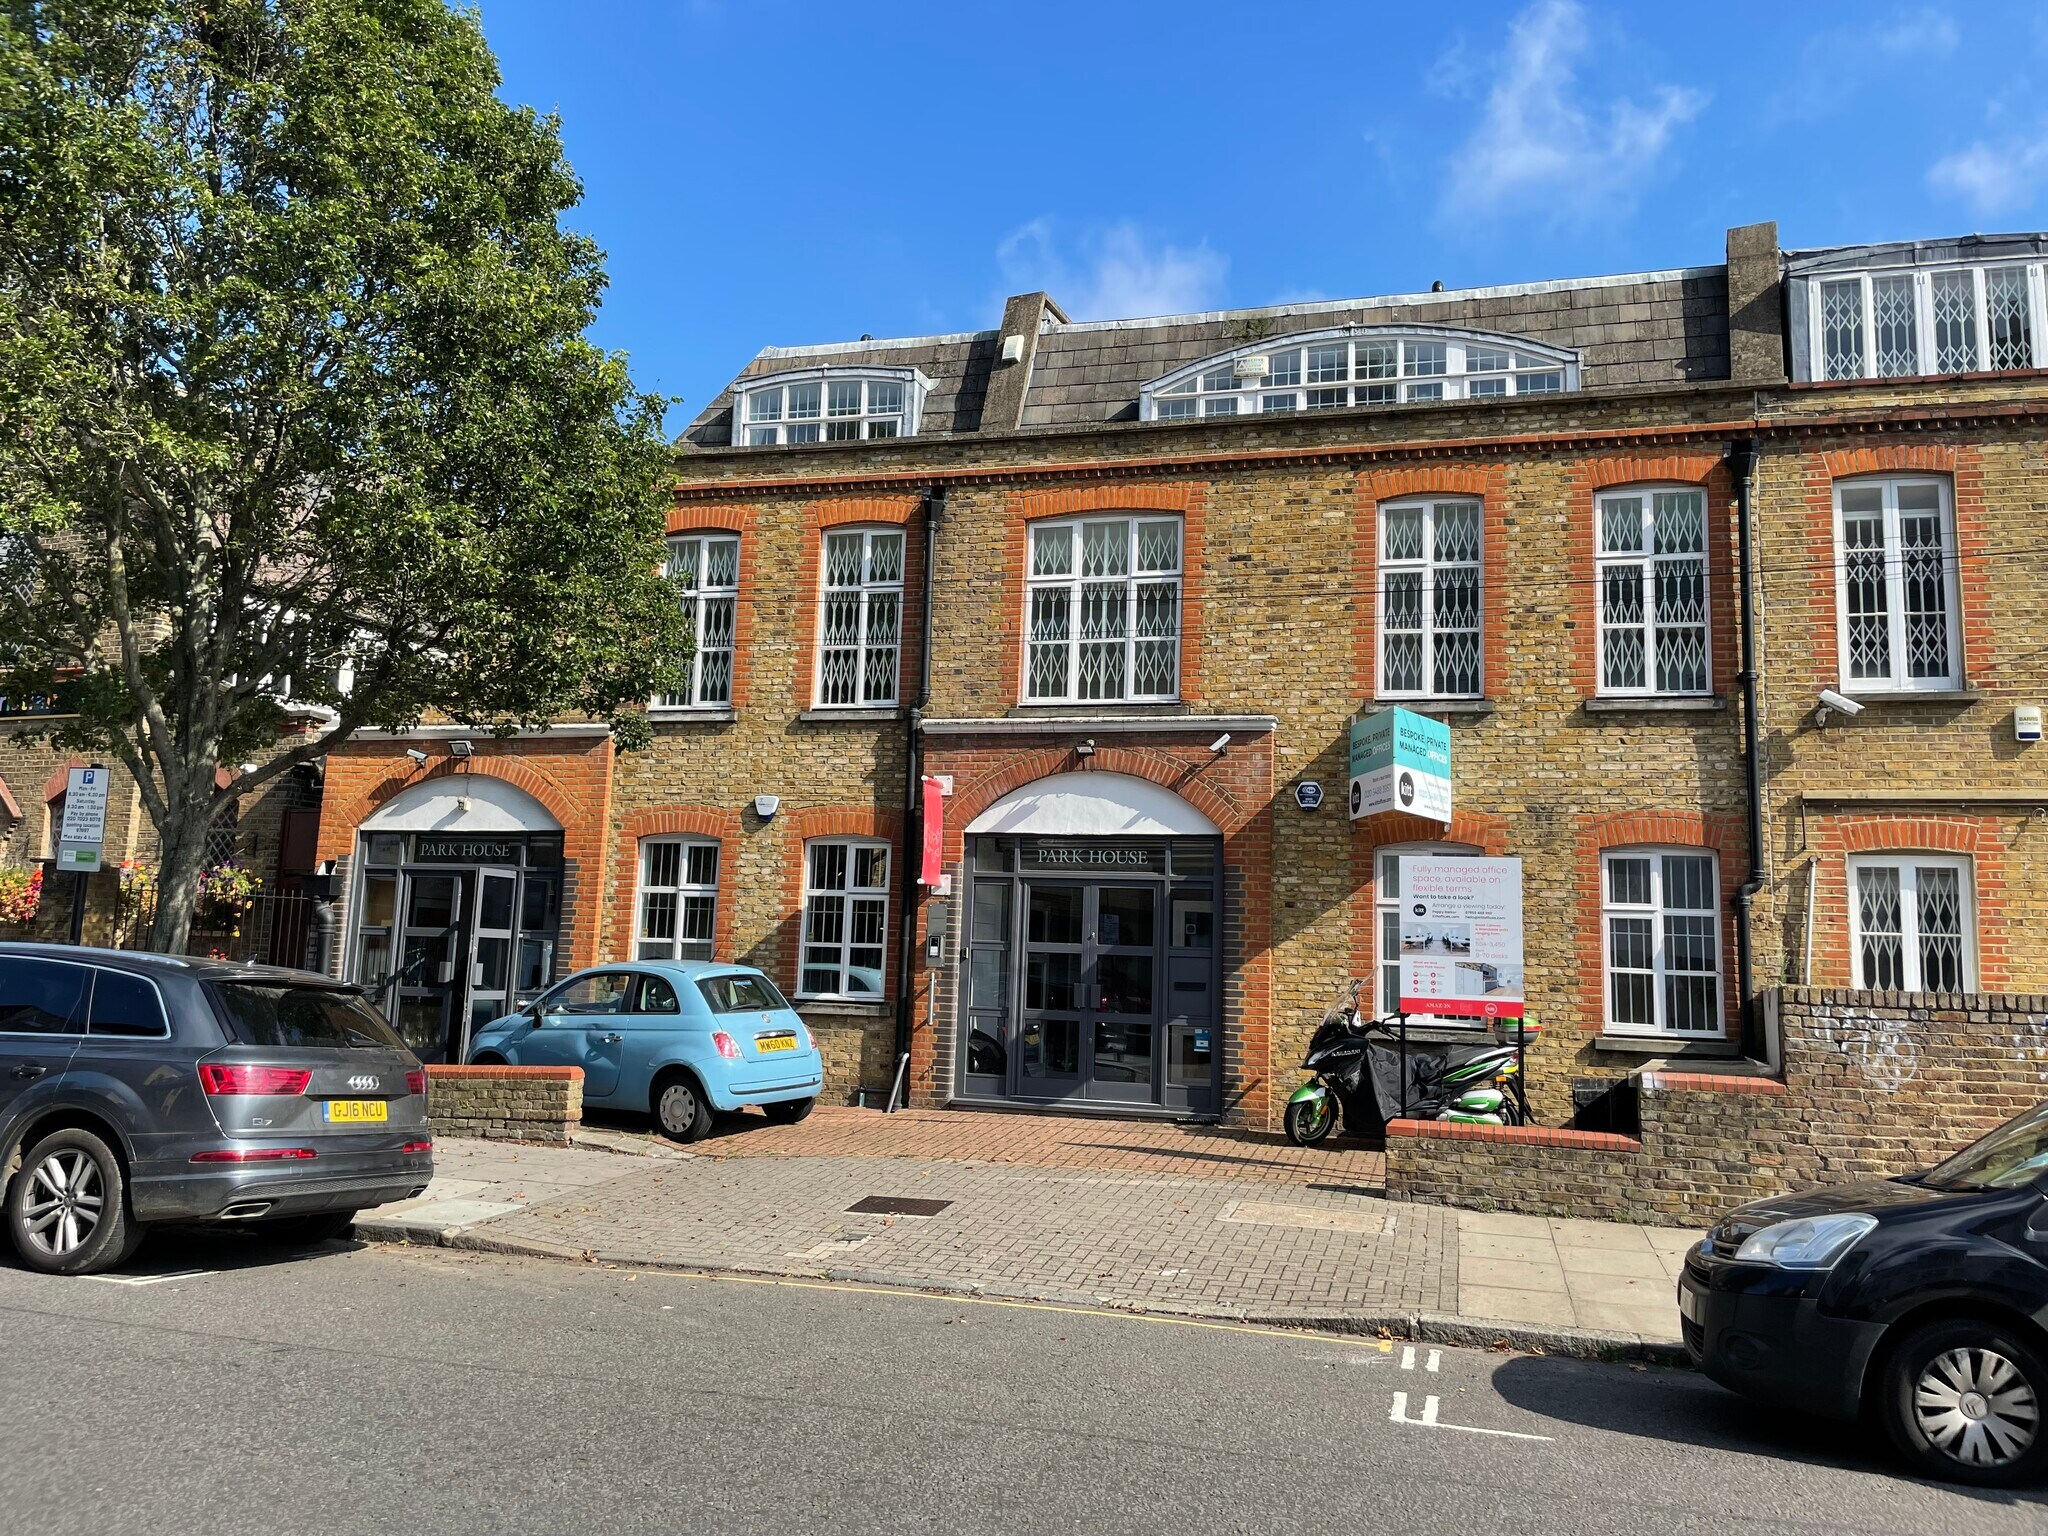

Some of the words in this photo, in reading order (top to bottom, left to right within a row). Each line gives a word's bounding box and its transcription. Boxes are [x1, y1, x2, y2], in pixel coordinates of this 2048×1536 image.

[1372, 728, 1390, 742] PRIVATE
[1427, 736, 1446, 751] PRIVATE
[1352, 748, 1372, 763] MANAGED
[1372, 741, 1391, 756] OFFICES
[1400, 740, 1426, 757] MANAGED
[1427, 750, 1448, 765] OFFICES
[86, 772, 93, 782] P
[1400, 781, 1412, 797] kitt
[420, 844, 457, 856] PARK
[462, 844, 510, 856] HOUSE
[1038, 849, 1084, 863] PARK
[1089, 850, 1148, 864] HOUSE
[1412, 865, 1431, 874] Fully
[1434, 866, 1479, 875] managed
[1482, 866, 1507, 874] office
[1412, 876, 1442, 884] space,
[1445, 876, 1486, 884] available
[1412, 884, 1443, 892] flexible
[334, 1102, 359, 1117] GJ16
[362, 1102, 382, 1116] NCU
